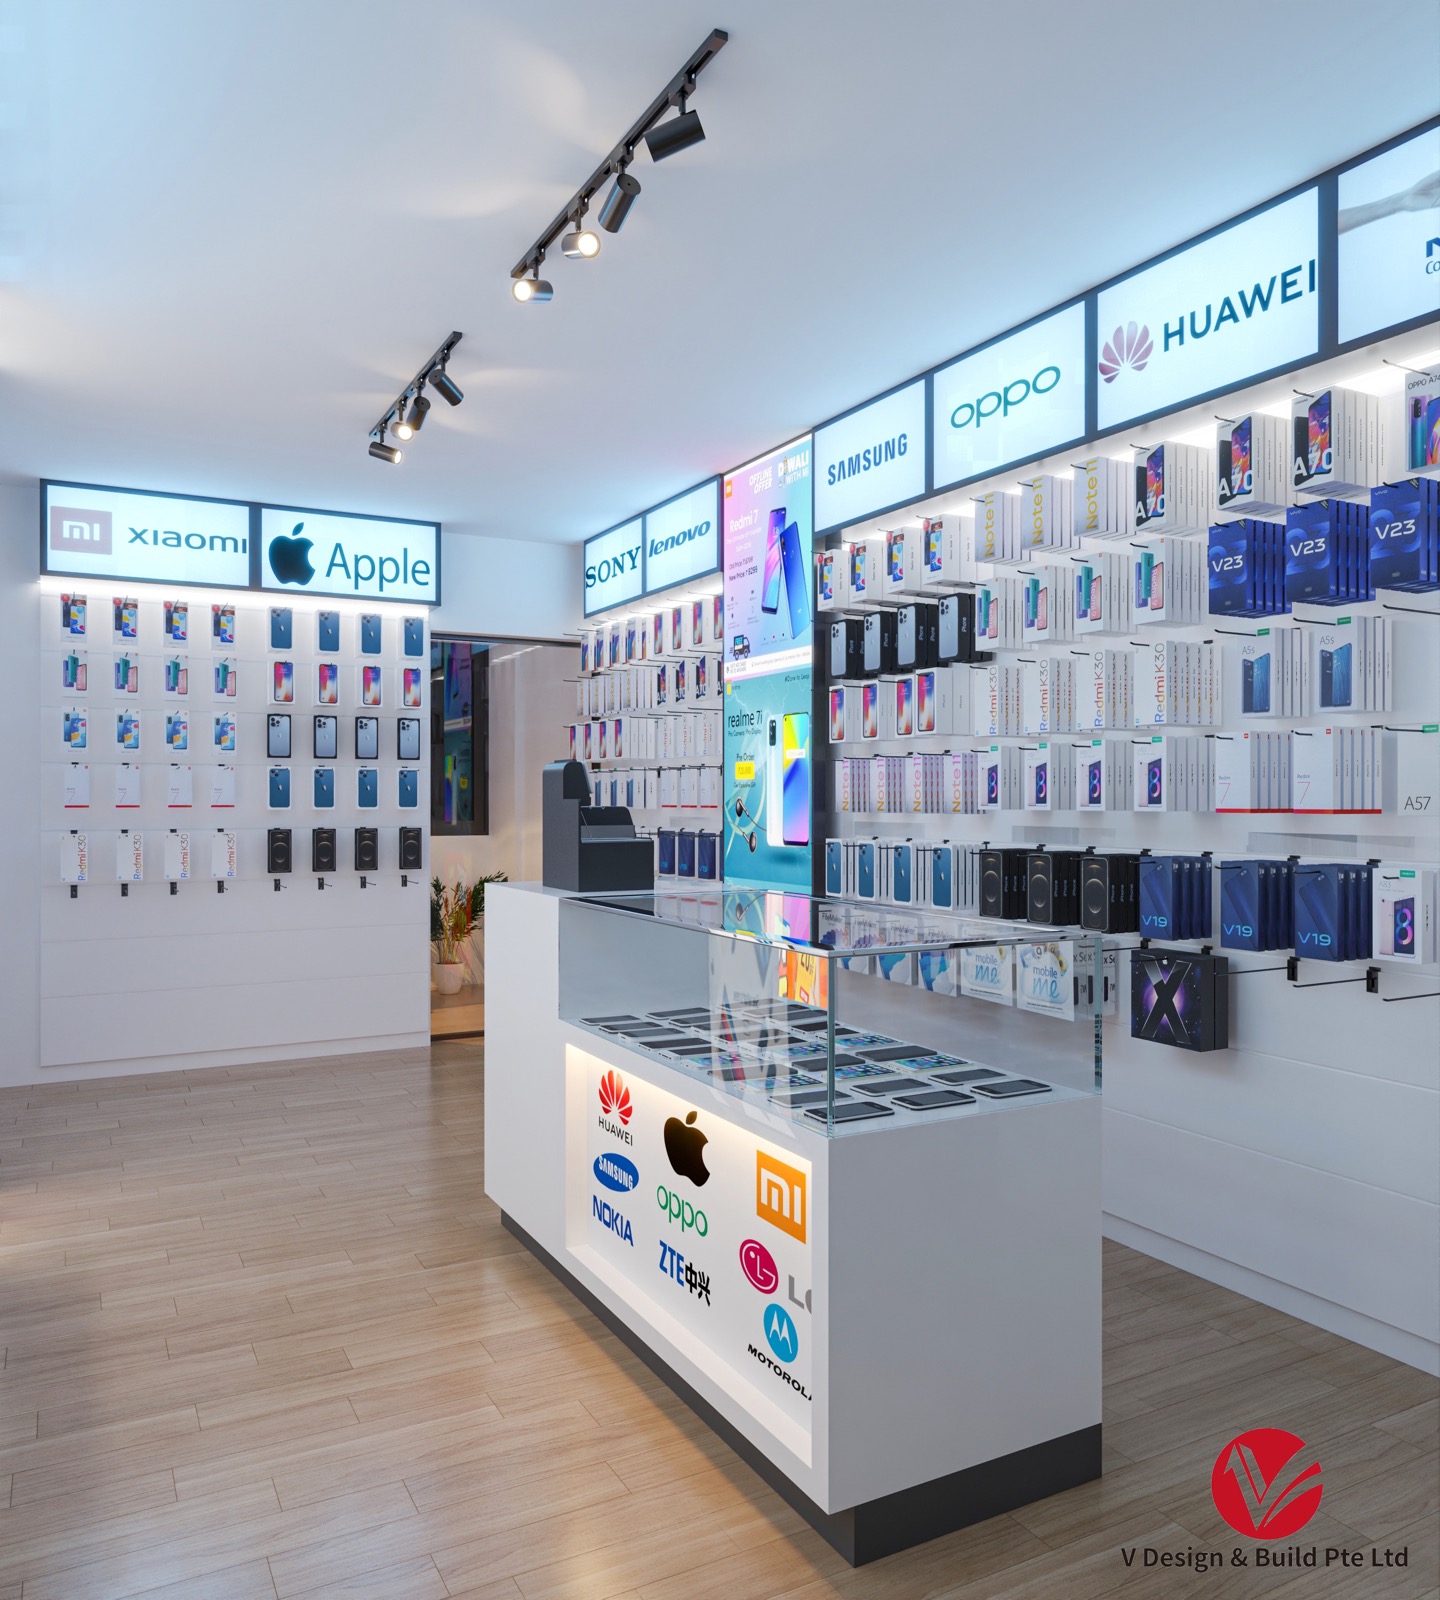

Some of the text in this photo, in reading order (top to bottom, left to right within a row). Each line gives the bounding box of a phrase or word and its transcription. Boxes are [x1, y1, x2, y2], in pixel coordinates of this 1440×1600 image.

[1163, 258, 1316, 353] HUAWEI
[950, 365, 1061, 429] oppo
[1407, 377, 1427, 390] OPPO
[749, 466, 773, 487] OFFLINE
[827, 432, 908, 486] SAMSUNG
[754, 480, 773, 494] OFFER
[1085, 459, 1098, 530] Note 11
[729, 509, 759, 533] Redmi 7
[984, 493, 995, 557] Note 11
[1032, 476, 1043, 545] Note 11
[128, 526, 248, 554] xiaomi
[648, 520, 711, 558] lenovo
[1289, 538, 1326, 557] V23
[1374, 519, 1416, 540] V23
[325, 542, 431, 592] Apple
[585, 545, 642, 589] SONY
[1211, 555, 1244, 573] V23
[1320, 635, 1334, 646] A5s
[989, 666, 997, 735] Redmi K30
[1039, 659, 1048, 731] Redmi K30
[1094, 651, 1104, 727] Redmi K30
[1154, 643, 1165, 723] Redmi K30
[728, 710, 763, 728] realme 7i
[877, 771, 885, 812] Note
[913, 770, 921, 812] Note
[952, 768, 961, 812] Note
[1218, 782, 1231, 805] 7
[1296, 781, 1311, 805] 7
[1404, 796, 1431, 811] A57
[78, 835, 86, 881] Redmi K30
[134, 834, 142, 880] Redmi K30
[181, 833, 189, 879] Redmi K30
[227, 850, 235, 877] Redmi
[1141, 915, 1168, 928] V19
[1223, 923, 1253, 937] V19
[1297, 931, 1332, 946] V19
[975, 953, 998, 965] mobile
[975, 964, 1000, 985] me
[1033, 966, 1058, 978] mobile
[1032, 977, 1060, 999] me
[1139, 953, 1192, 1045] X
[598, 1115, 633, 1147] HUAWEI
[598, 1154, 633, 1191] SAMSUNG
[592, 1194, 634, 1247] NOKIA
[656, 1185, 708, 1238] oppo
